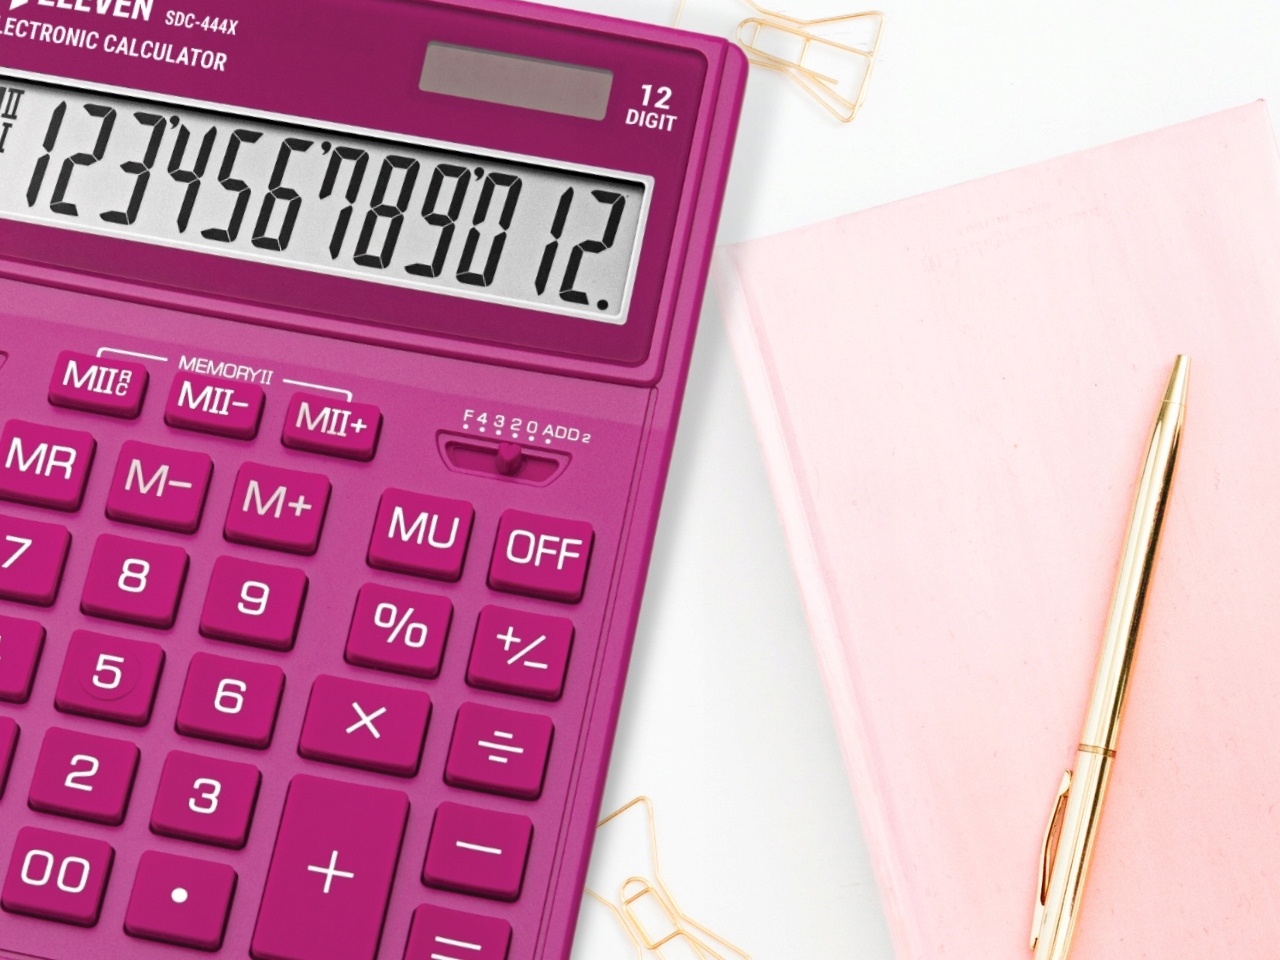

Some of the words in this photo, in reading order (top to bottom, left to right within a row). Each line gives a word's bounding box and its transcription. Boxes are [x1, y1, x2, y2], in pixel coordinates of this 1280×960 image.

[164, 10, 239, 36] SDC-444X
[0, 15, 100, 50] ECTRONIC
[103, 34, 228, 72] CALCULATOR
[641, 84, 672, 110] 12
[625, 108, 678, 132] DIGIT
[178, 355, 274, 385] MEMORYII
[296, 402, 367, 437] MII+
[5, 437, 77, 480] MR
[242, 480, 312, 518] M+
[388, 506, 460, 549] MU
[1, 535, 33, 569] 7
[506, 529, 583, 570] OFF
[117, 558, 150, 593] 8
[237, 580, 270, 616] 9
[374, 602, 428, 648] %
[92, 653, 125, 689] 5
[214, 678, 247, 714] 6
[64, 754, 99, 792] 2
[188, 777, 222, 814] 3
[21, 849, 90, 893] 00
